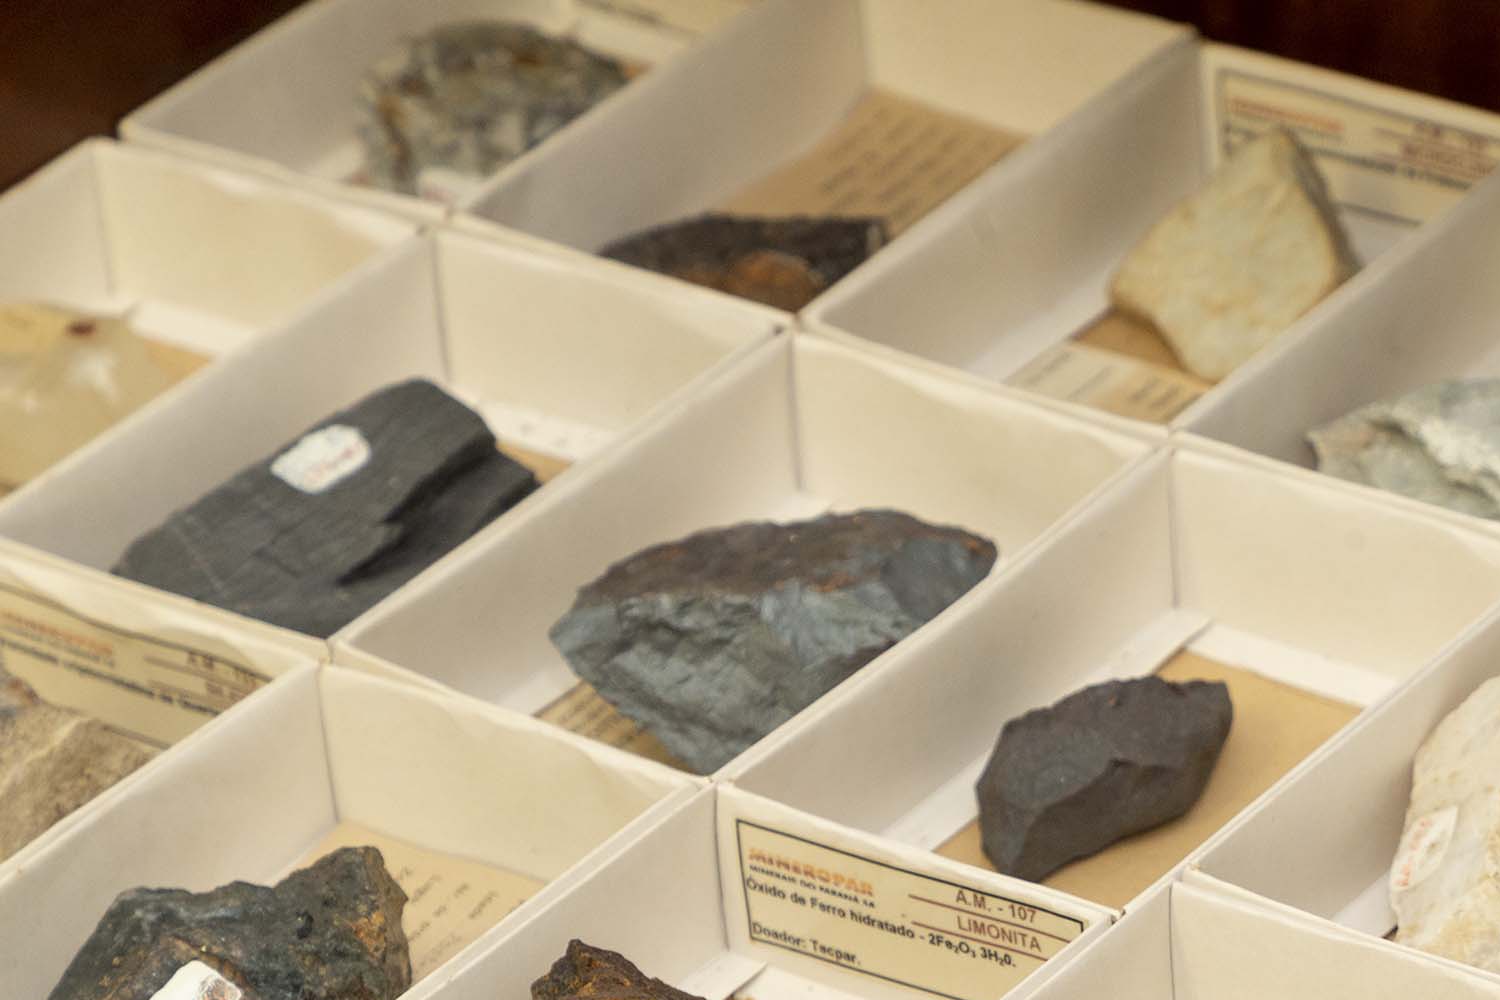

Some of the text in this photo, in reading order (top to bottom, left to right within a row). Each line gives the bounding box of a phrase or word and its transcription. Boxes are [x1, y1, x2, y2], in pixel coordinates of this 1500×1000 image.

[749, 848, 873, 897] MINEROPAR
[790, 891, 806, 905] de
[810, 896, 846, 918] Ferro
[849, 909, 915, 939] hidratado
[956, 890, 991, 912] A.M.
[1008, 904, 1037, 923] 107
[752, 921, 861, 965] Doador: Tecpar.
[957, 915, 1042, 953] LIMONITA
